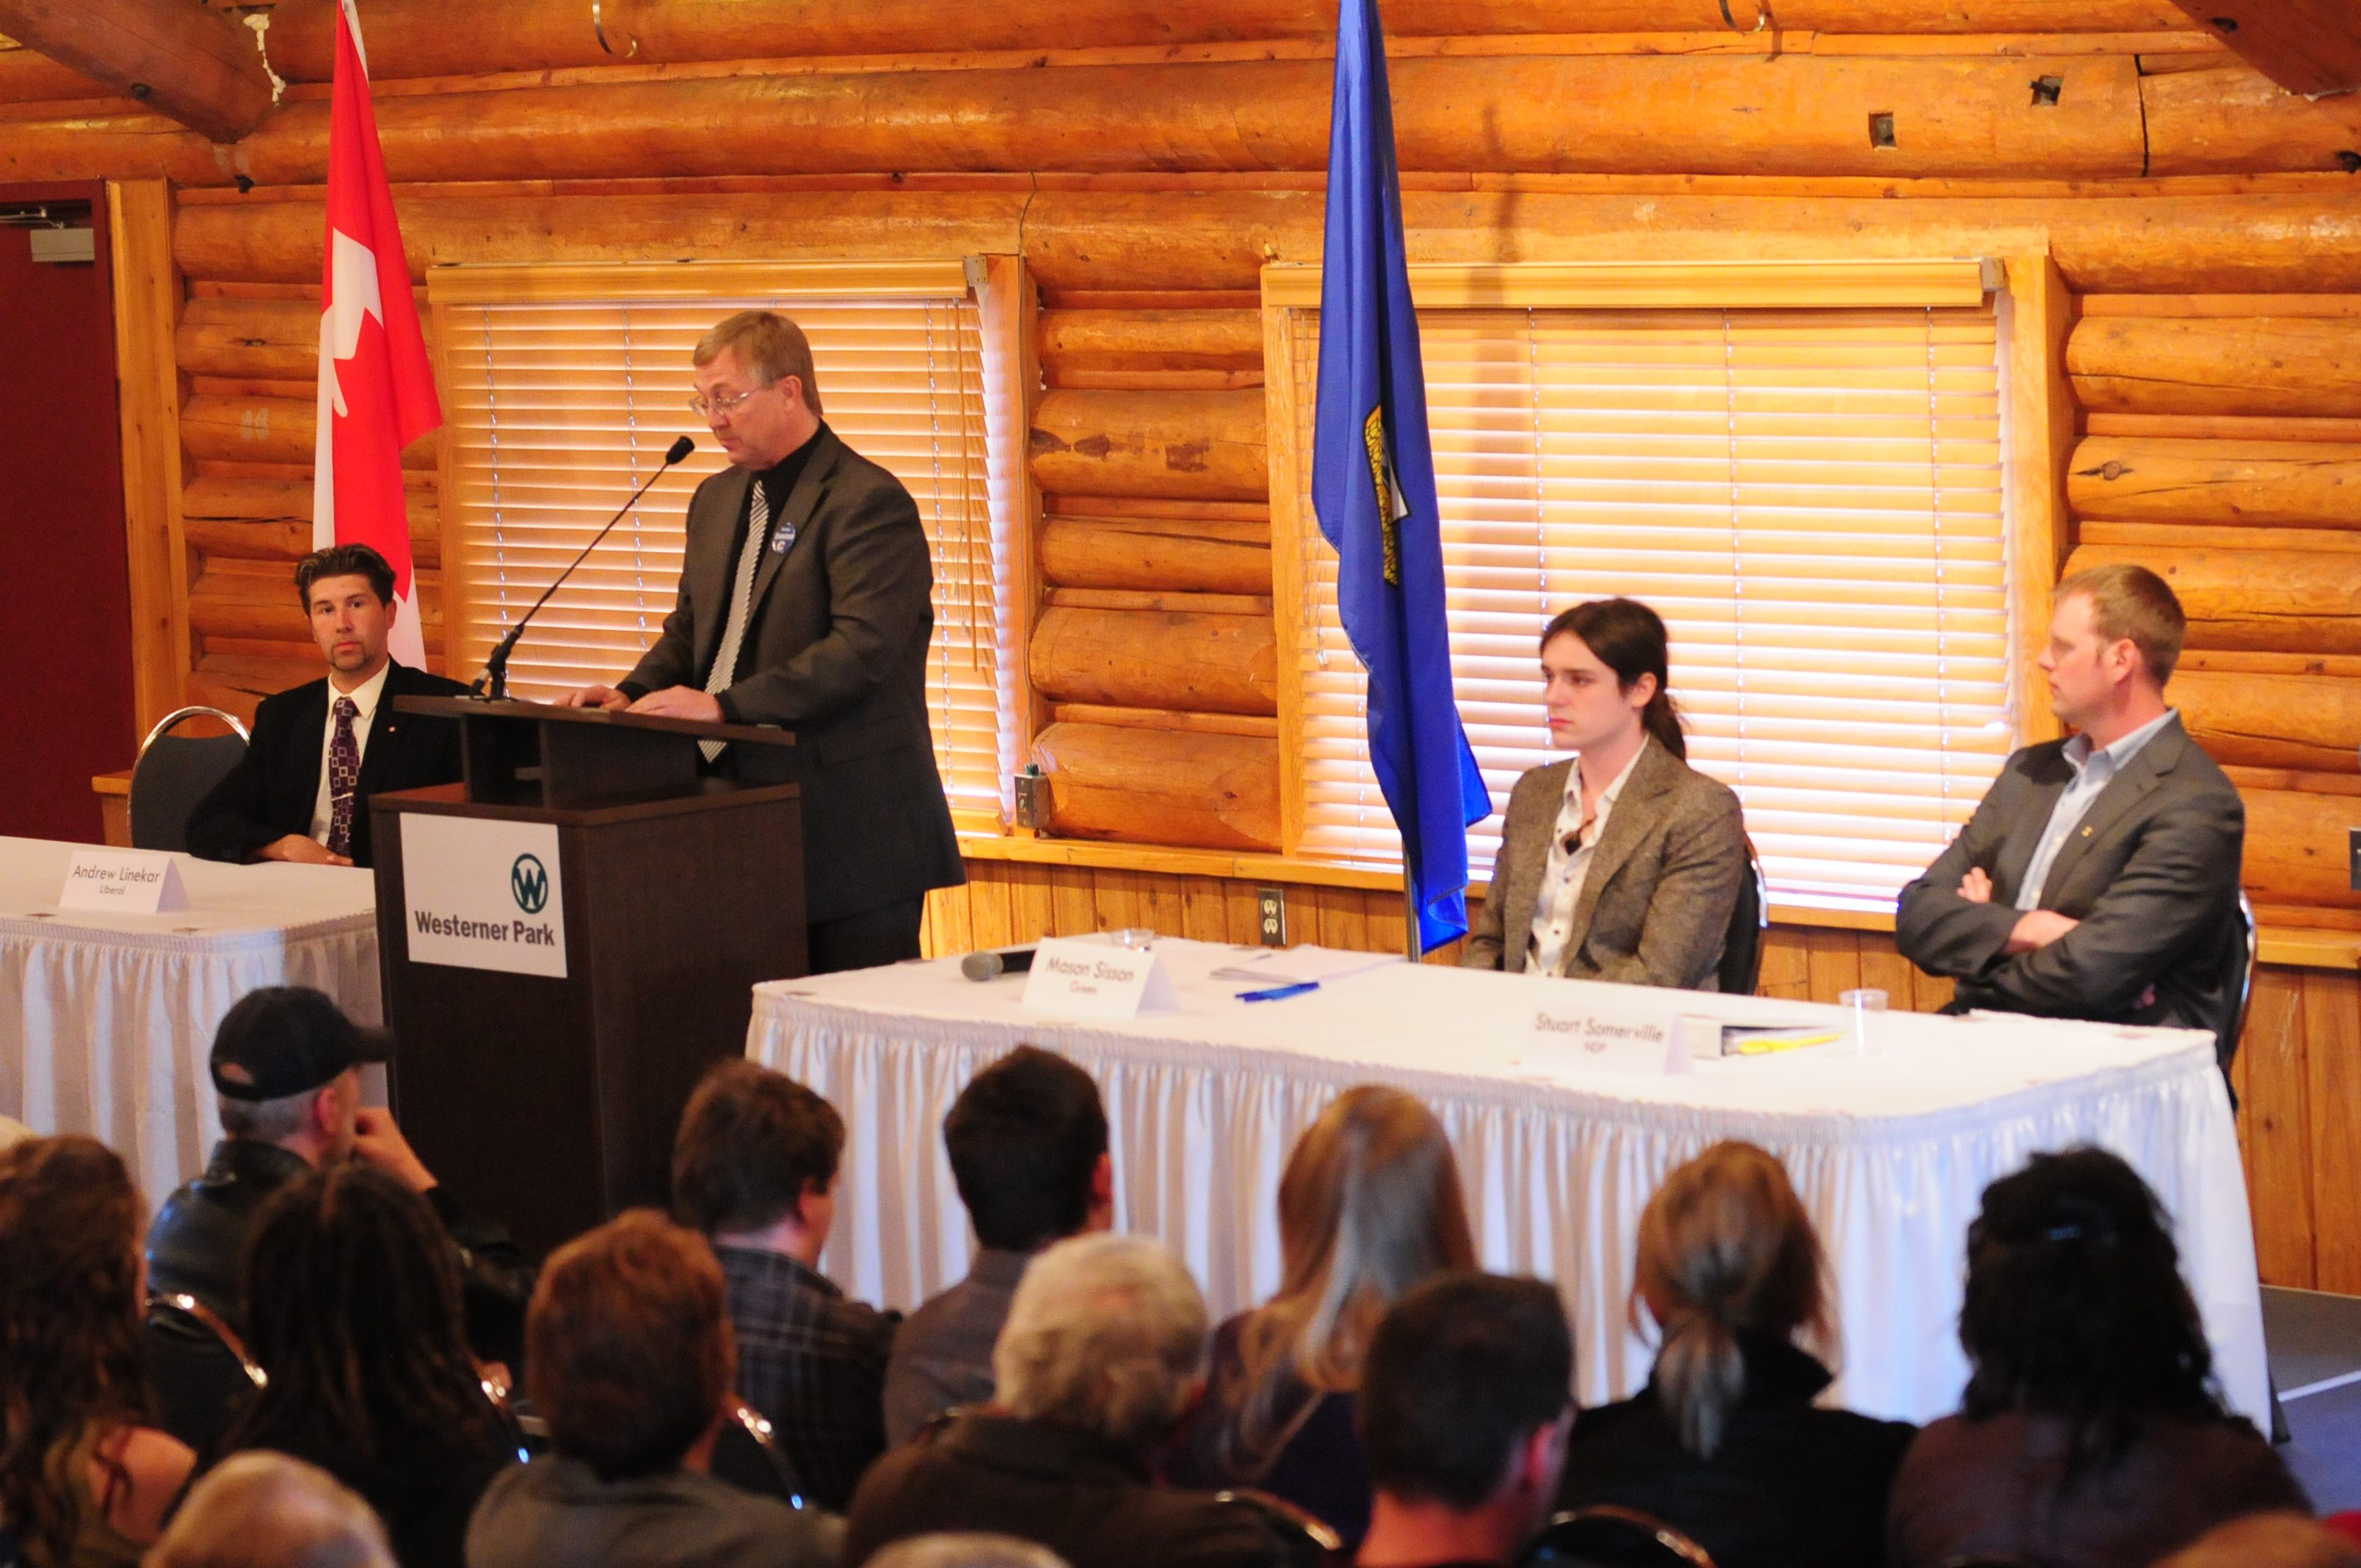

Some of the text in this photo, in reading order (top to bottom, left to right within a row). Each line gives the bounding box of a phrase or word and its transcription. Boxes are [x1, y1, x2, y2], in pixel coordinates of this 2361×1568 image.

[72, 864, 160, 883] Andrew Linekar
[100, 885, 126, 896] Liberal
[414, 910, 556, 946] Westerner Park
[1046, 957, 1134, 981] Mason Sisson
[1535, 1012, 1664, 1042] Stuart Somerville
